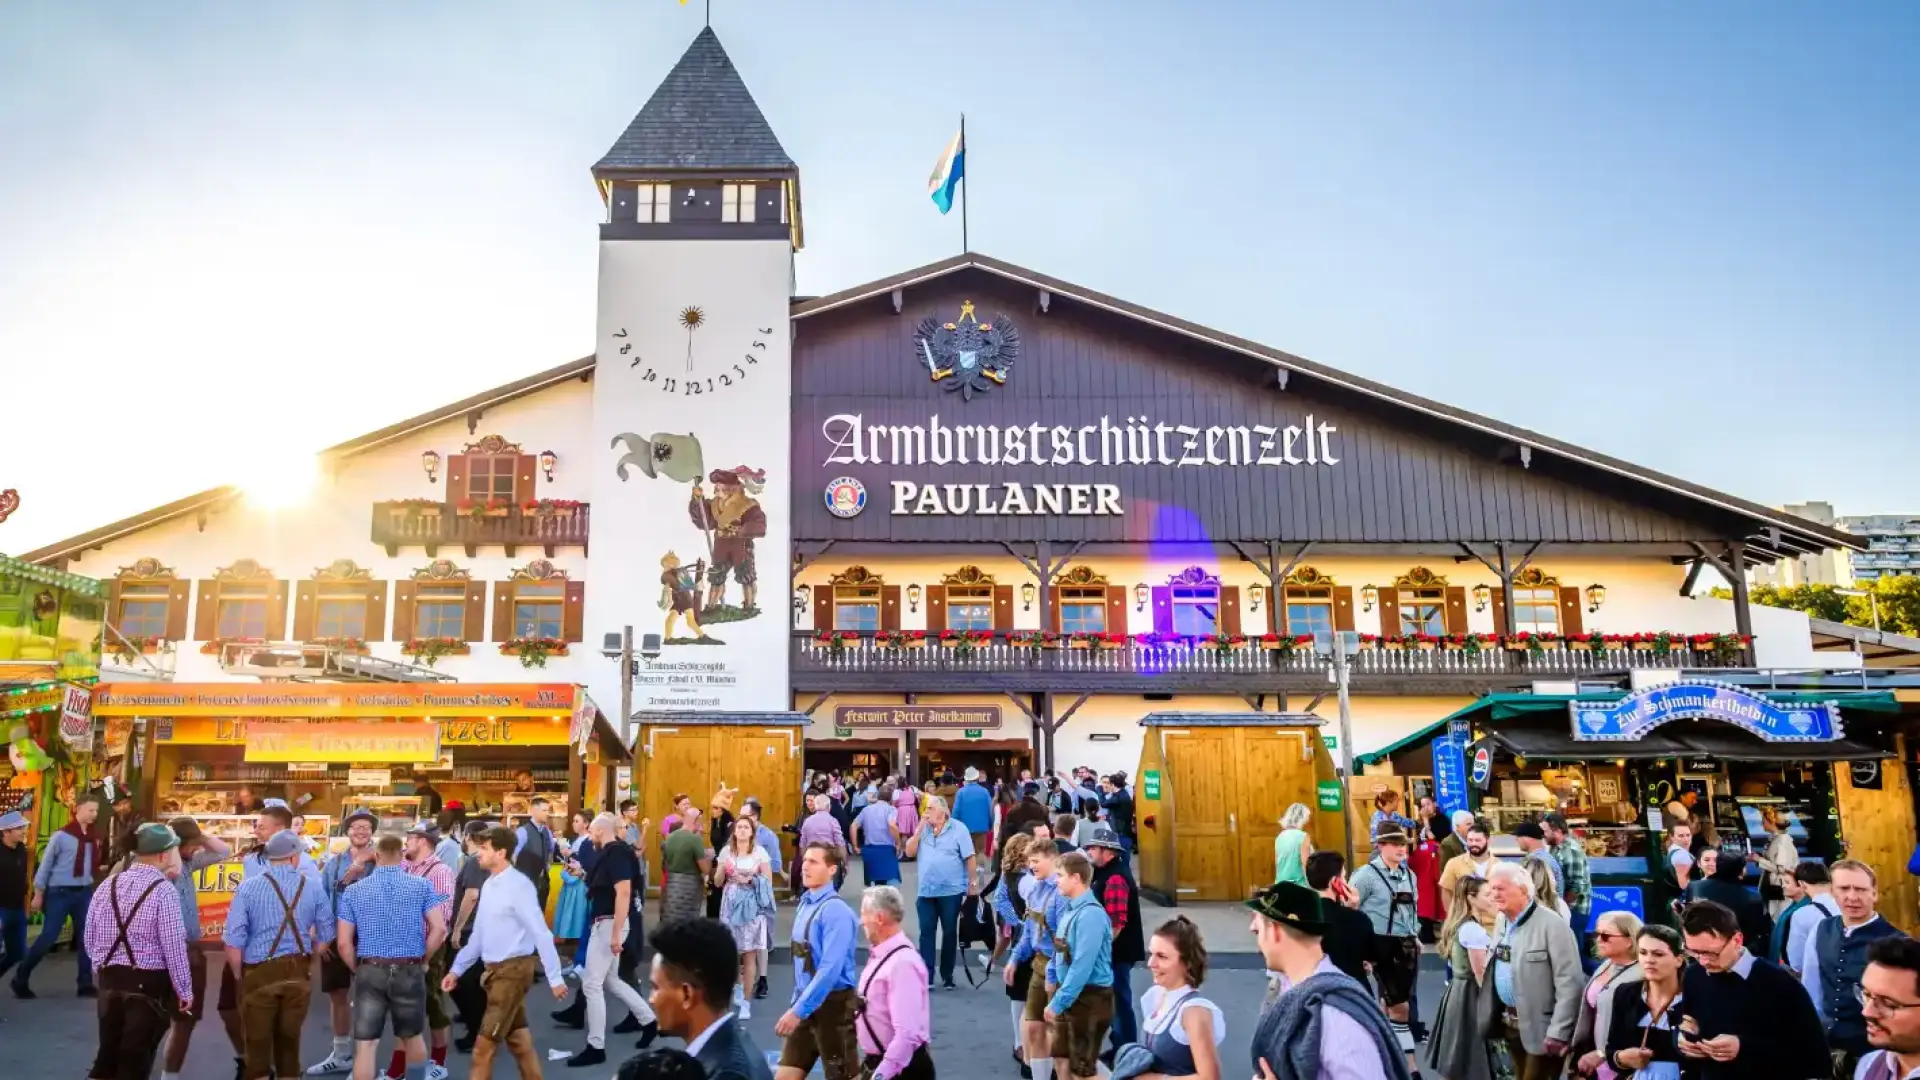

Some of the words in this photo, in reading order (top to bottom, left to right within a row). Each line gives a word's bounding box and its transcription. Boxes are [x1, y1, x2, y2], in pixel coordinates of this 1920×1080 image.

[612, 328, 628, 338] 7
[620, 343, 632, 355] 8
[631, 356, 641, 367] 9
[642, 368, 658, 381] 10
[663, 378, 676, 392] 11
[684, 381, 703, 396] 12
[707, 379, 714, 392] 1
[719, 374, 732, 385] 2
[733, 364, 746, 379] 3
[745, 354, 757, 364] 4
[752, 340, 766, 350] 5
[821, 413, 1341, 468] Armbrustschützenzelt
[890, 480, 1124, 516] PAULANER
[843, 709, 889, 724] Festwirt
[892, 709, 925, 725] Peter
[928, 709, 992, 724] Inselkammer
[1612, 708, 1640, 729] Zur
[196, 863, 242, 893] Lis
